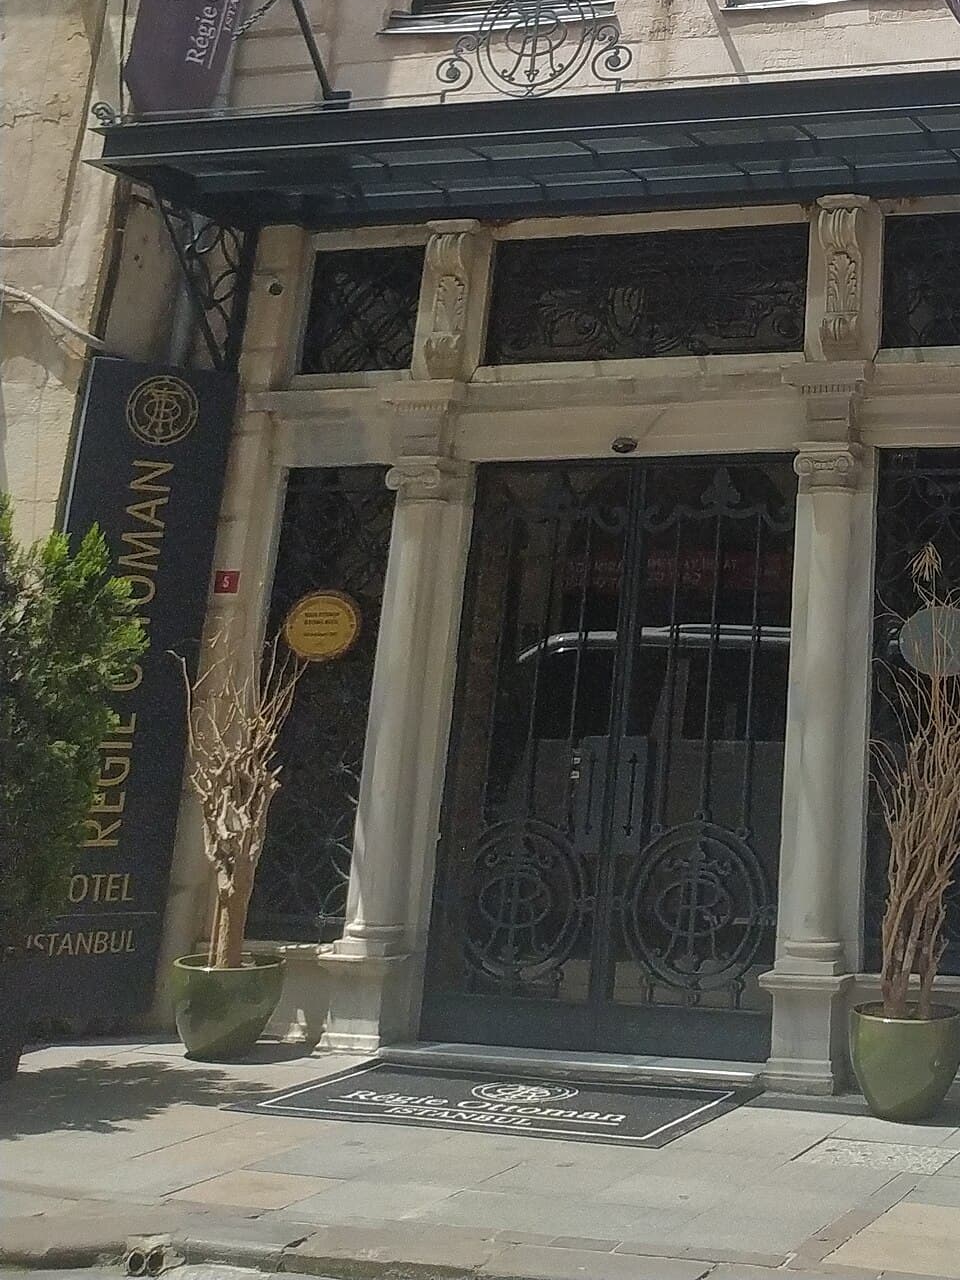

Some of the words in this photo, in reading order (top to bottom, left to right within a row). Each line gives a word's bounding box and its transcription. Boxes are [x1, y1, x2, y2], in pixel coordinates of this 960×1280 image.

[185, 5, 218, 65] Régie
[341, 1089, 449, 1105] Régie
[457, 1099, 627, 1123] Ottoman
[384, 1106, 533, 1126] ISTANBUL
